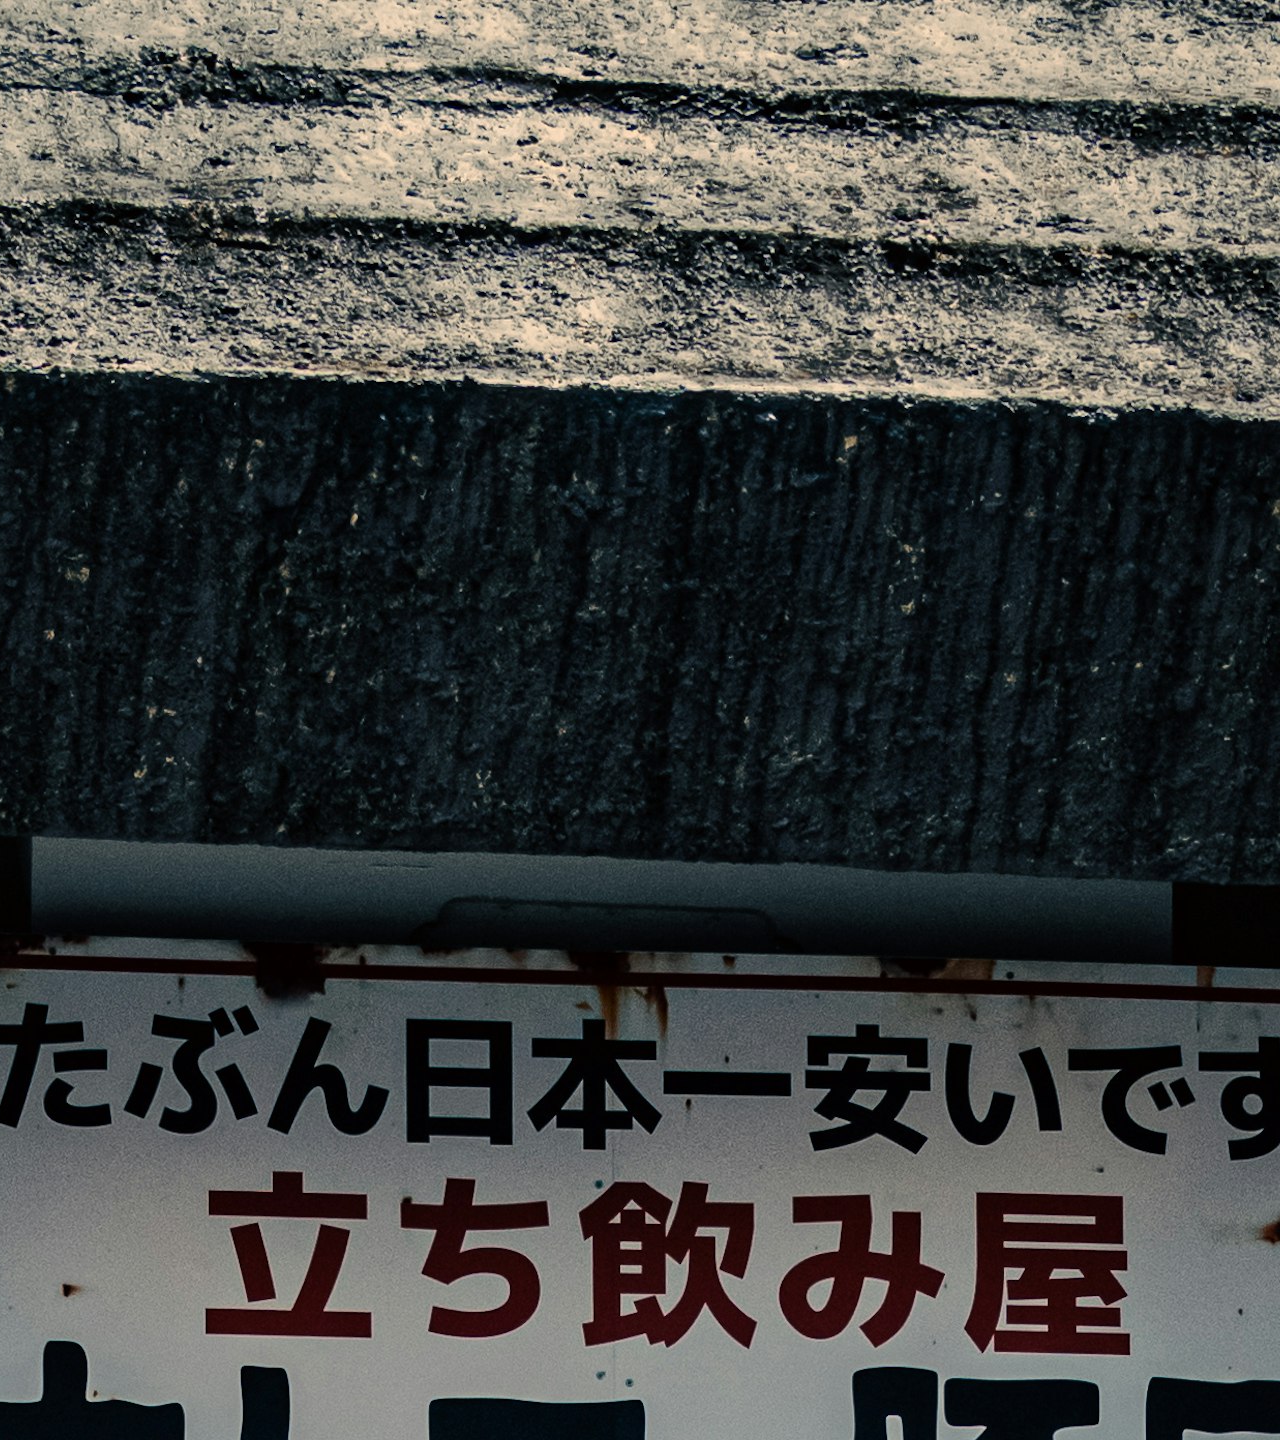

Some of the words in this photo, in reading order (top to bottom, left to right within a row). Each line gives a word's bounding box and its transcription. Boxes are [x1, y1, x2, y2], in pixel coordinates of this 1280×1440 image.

[205, 1171, 1131, 1356] 立ち飲み屋
